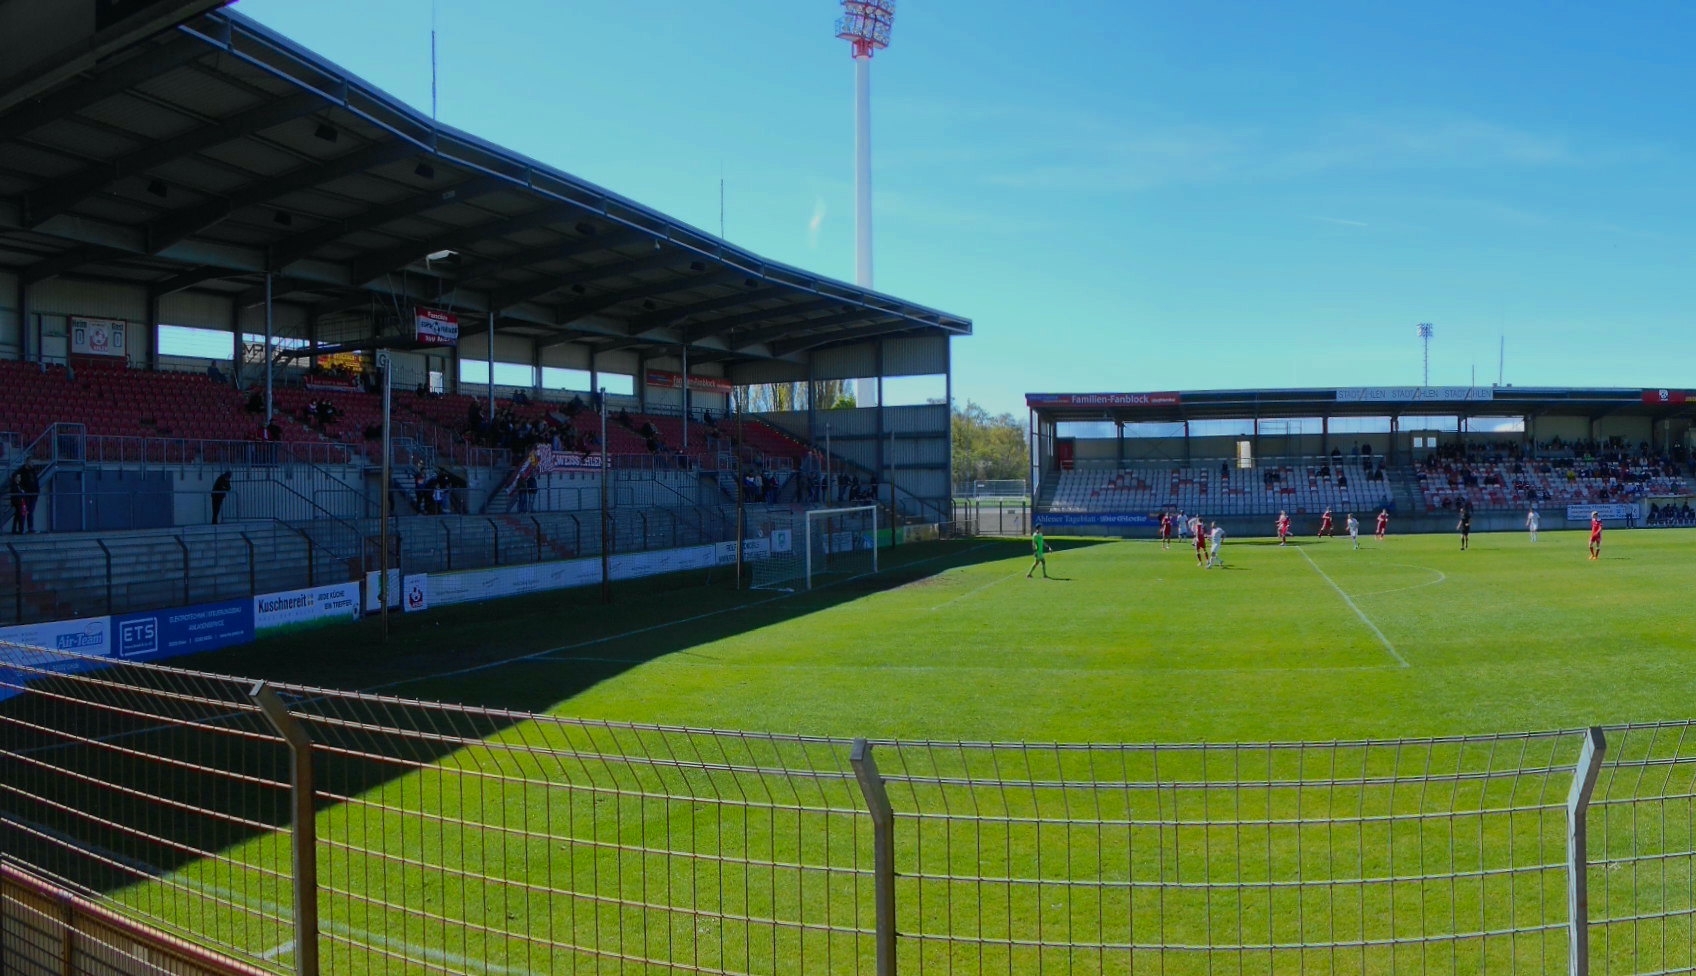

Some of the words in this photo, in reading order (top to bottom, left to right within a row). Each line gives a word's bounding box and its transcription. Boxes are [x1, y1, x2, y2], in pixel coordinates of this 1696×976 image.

[73, 320, 87, 328] Heim
[379, 354, 386, 366] G
[1072, 395, 1149, 404] Familien-Fanblock
[1036, 514, 1063, 522] Ahlener
[1066, 515, 1097, 524] Tageblatt
[258, 594, 307, 614] Kuschnereit
[124, 624, 154, 642] ETS
[57, 633, 103, 649] Air-Team
